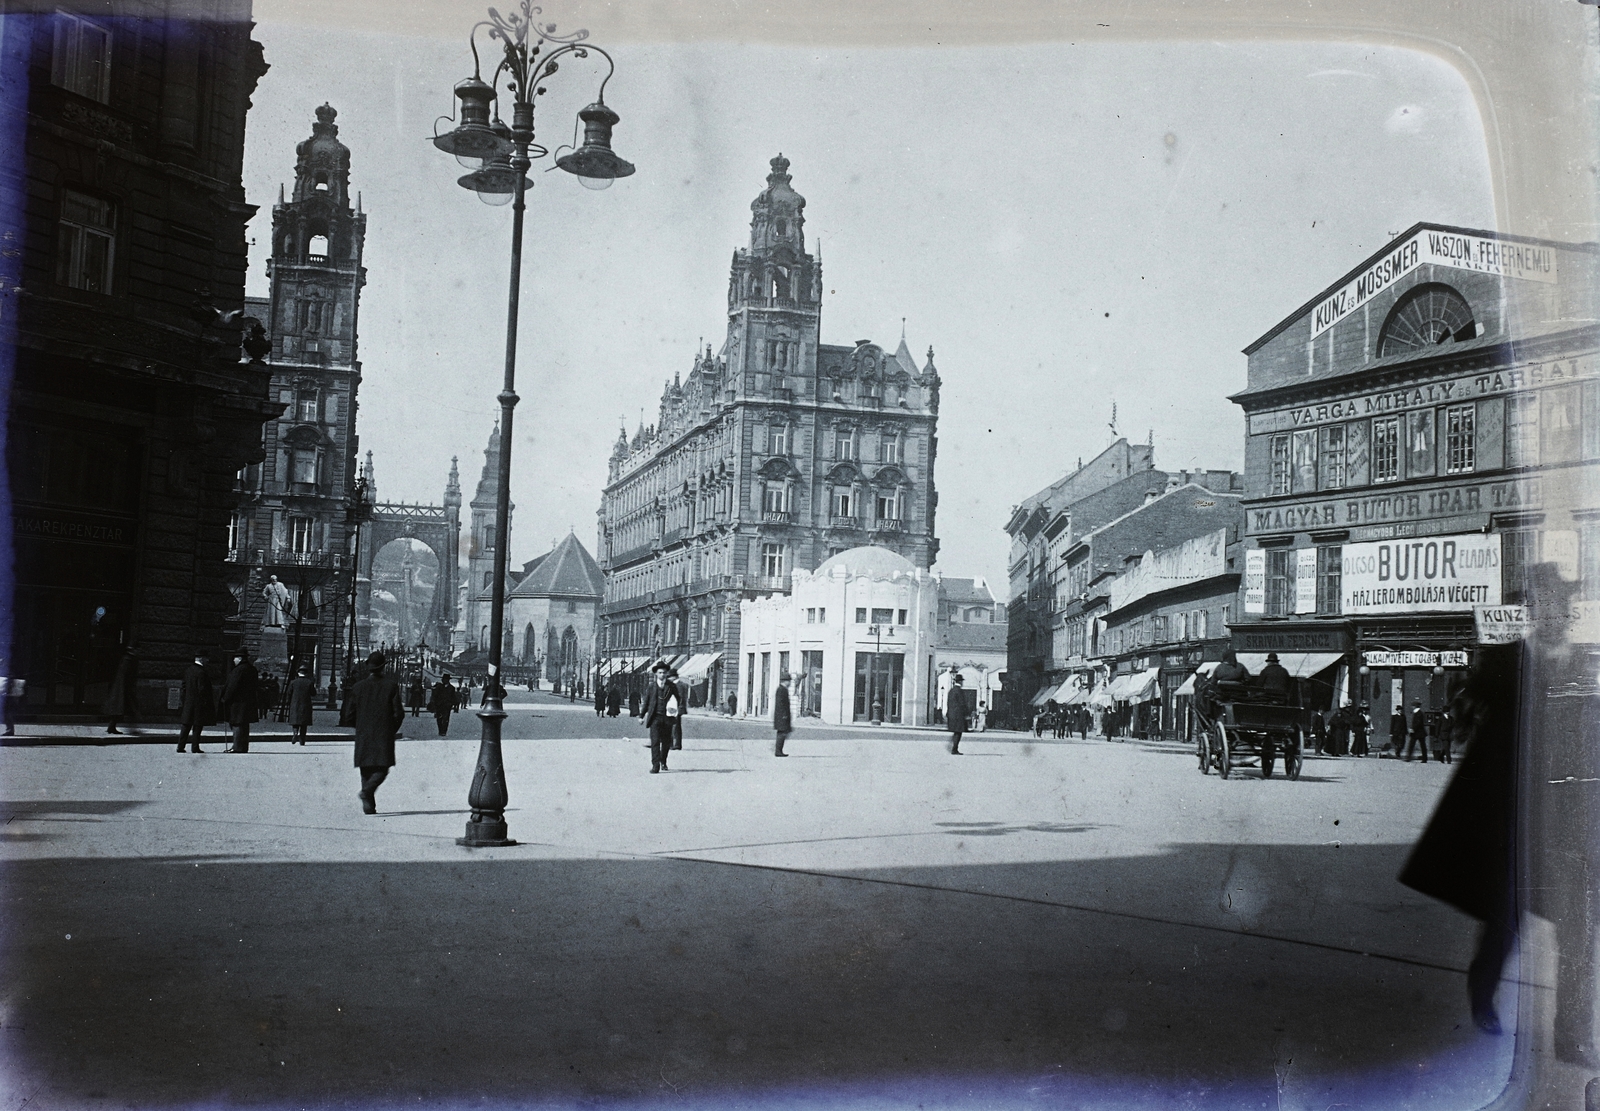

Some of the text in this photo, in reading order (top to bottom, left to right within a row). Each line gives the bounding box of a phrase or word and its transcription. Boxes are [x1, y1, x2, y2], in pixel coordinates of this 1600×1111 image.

[1316, 291, 1347, 332] KUNZ
[1290, 401, 1359, 425] VARGA
[1254, 504, 1336, 531] MAGYAR
[1428, 487, 1482, 514] IPAR
[1297, 564, 1316, 579] BUTOR
[1378, 541, 1457, 581] BUTOR
[1352, 587, 1370, 606] HÁZ
[1448, 582, 1489, 603] VÉGETT
[1483, 609, 1523, 622] KUNZ
